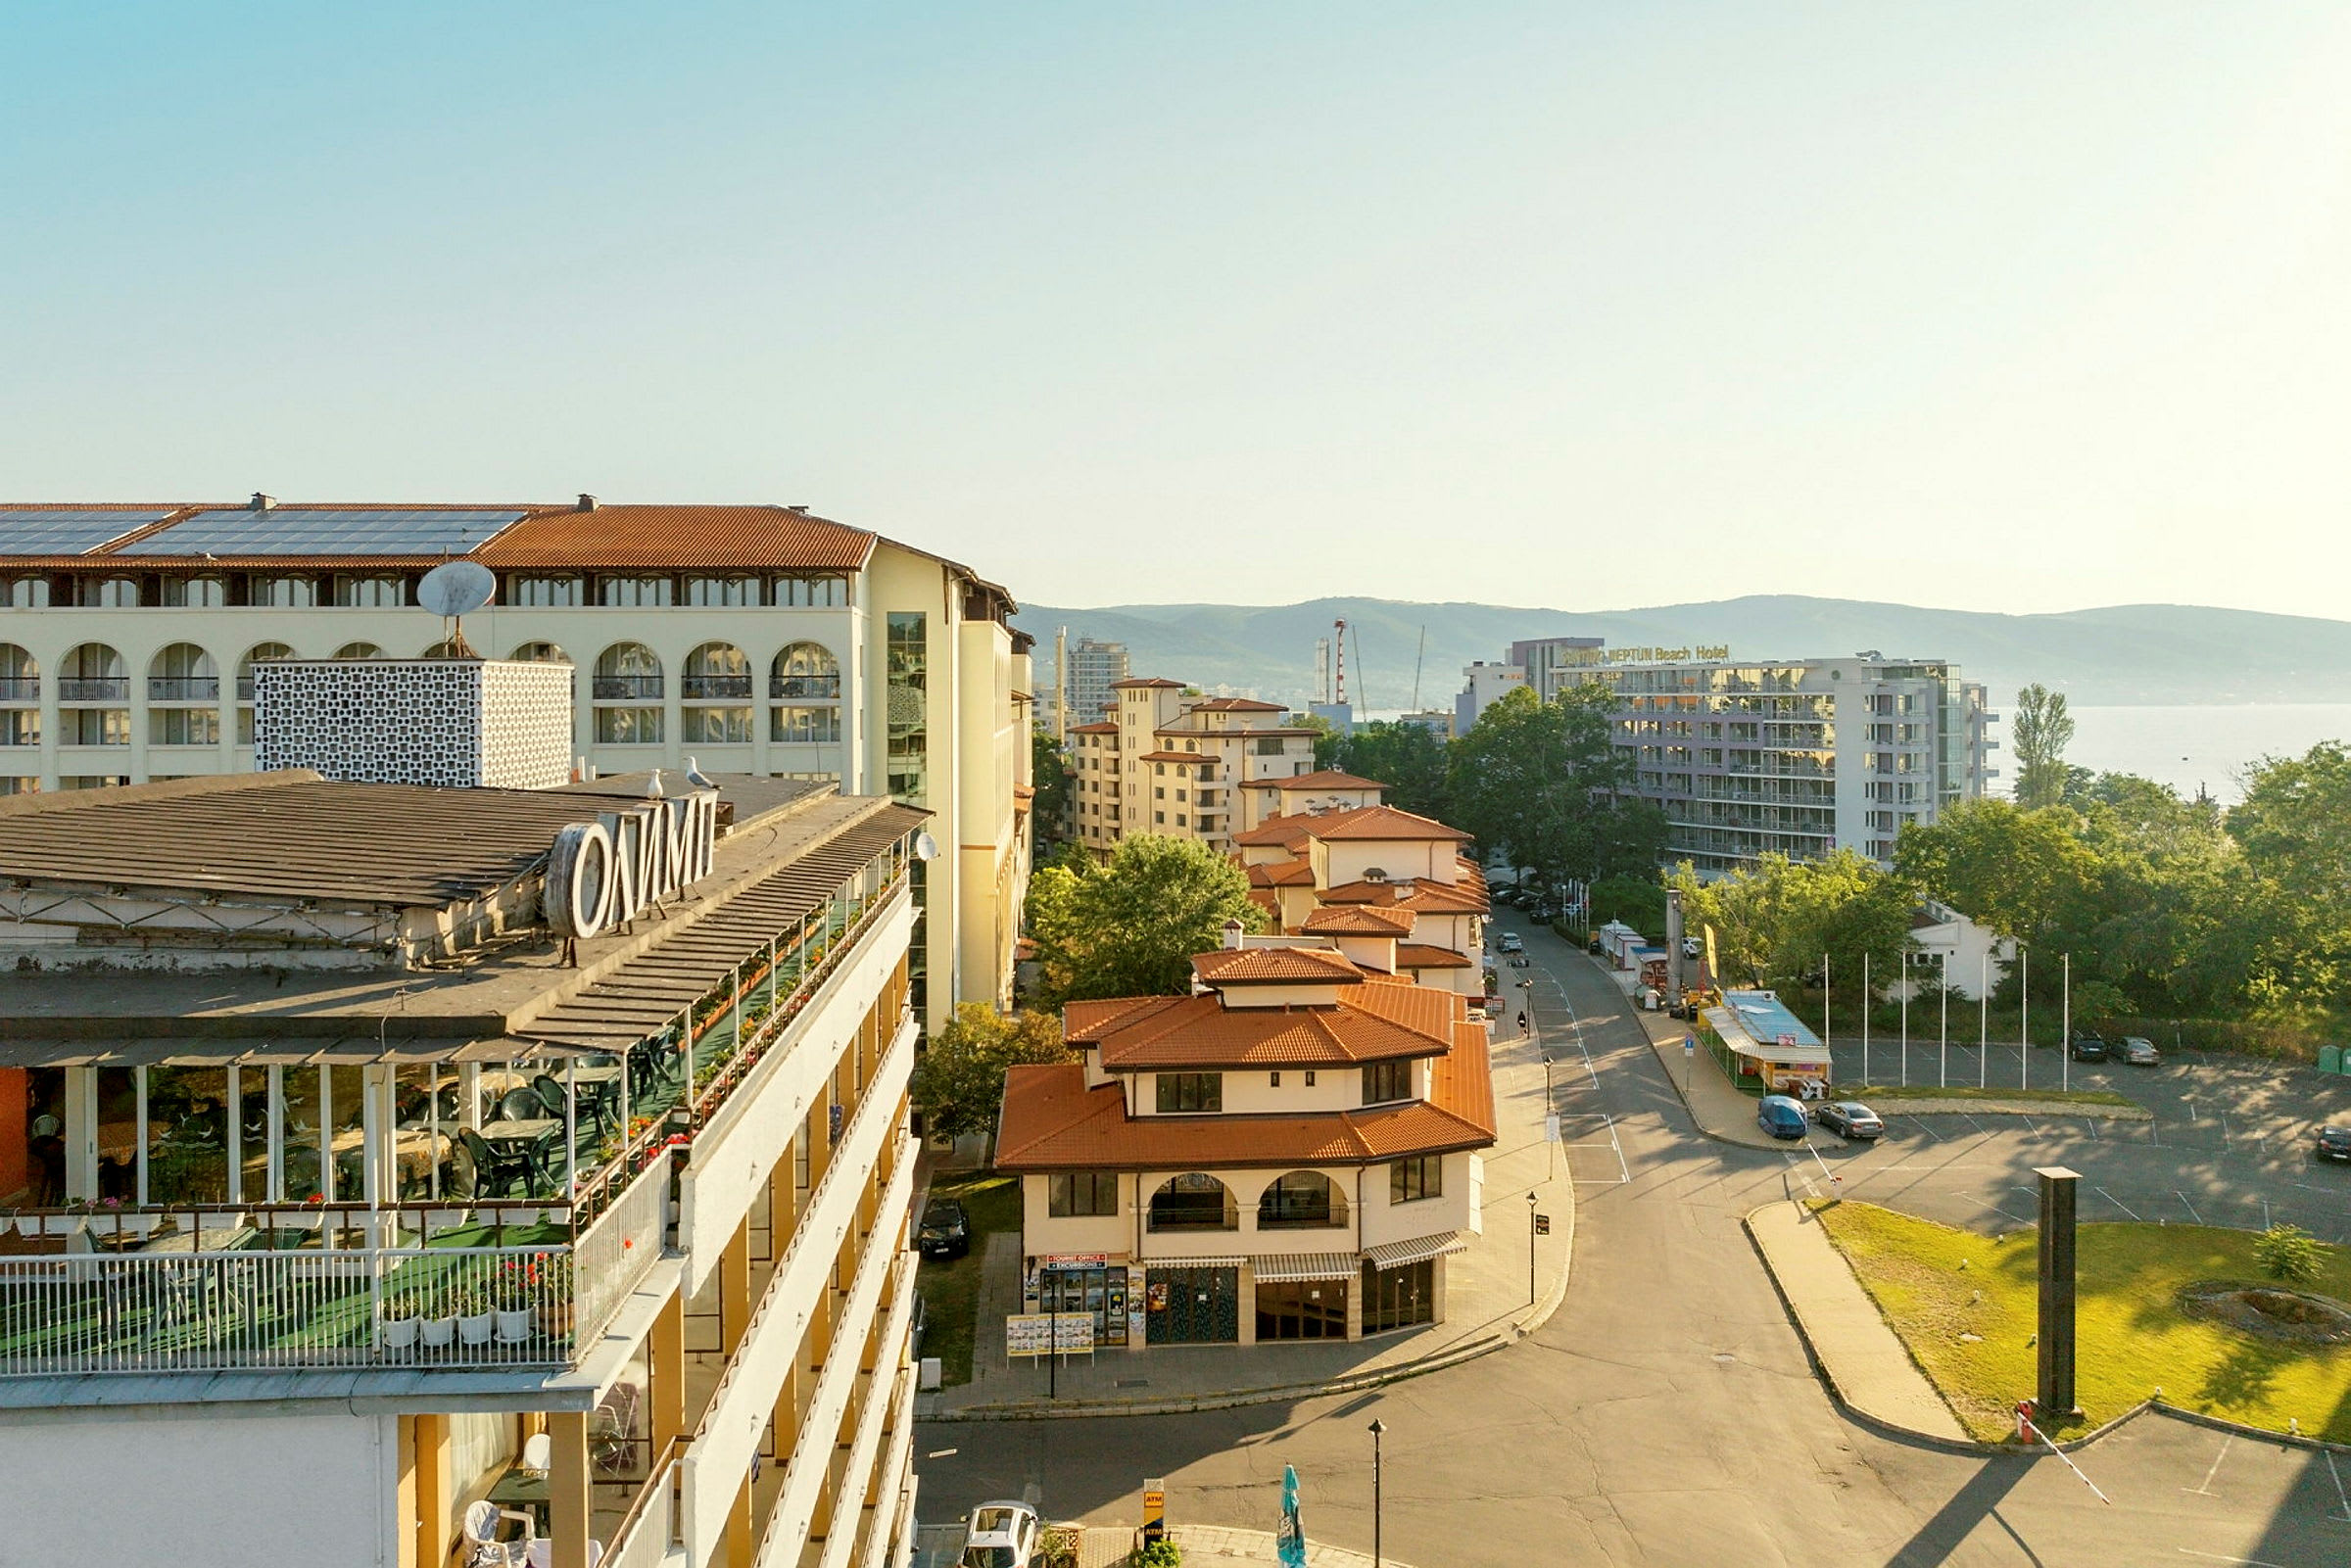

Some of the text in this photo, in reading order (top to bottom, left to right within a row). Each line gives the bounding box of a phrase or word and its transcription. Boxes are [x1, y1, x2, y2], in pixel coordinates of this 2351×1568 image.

[1608, 647, 1653, 662] NEPTUN
[1655, 646, 1691, 661] Beach
[1697, 644, 1728, 659] Hotel
